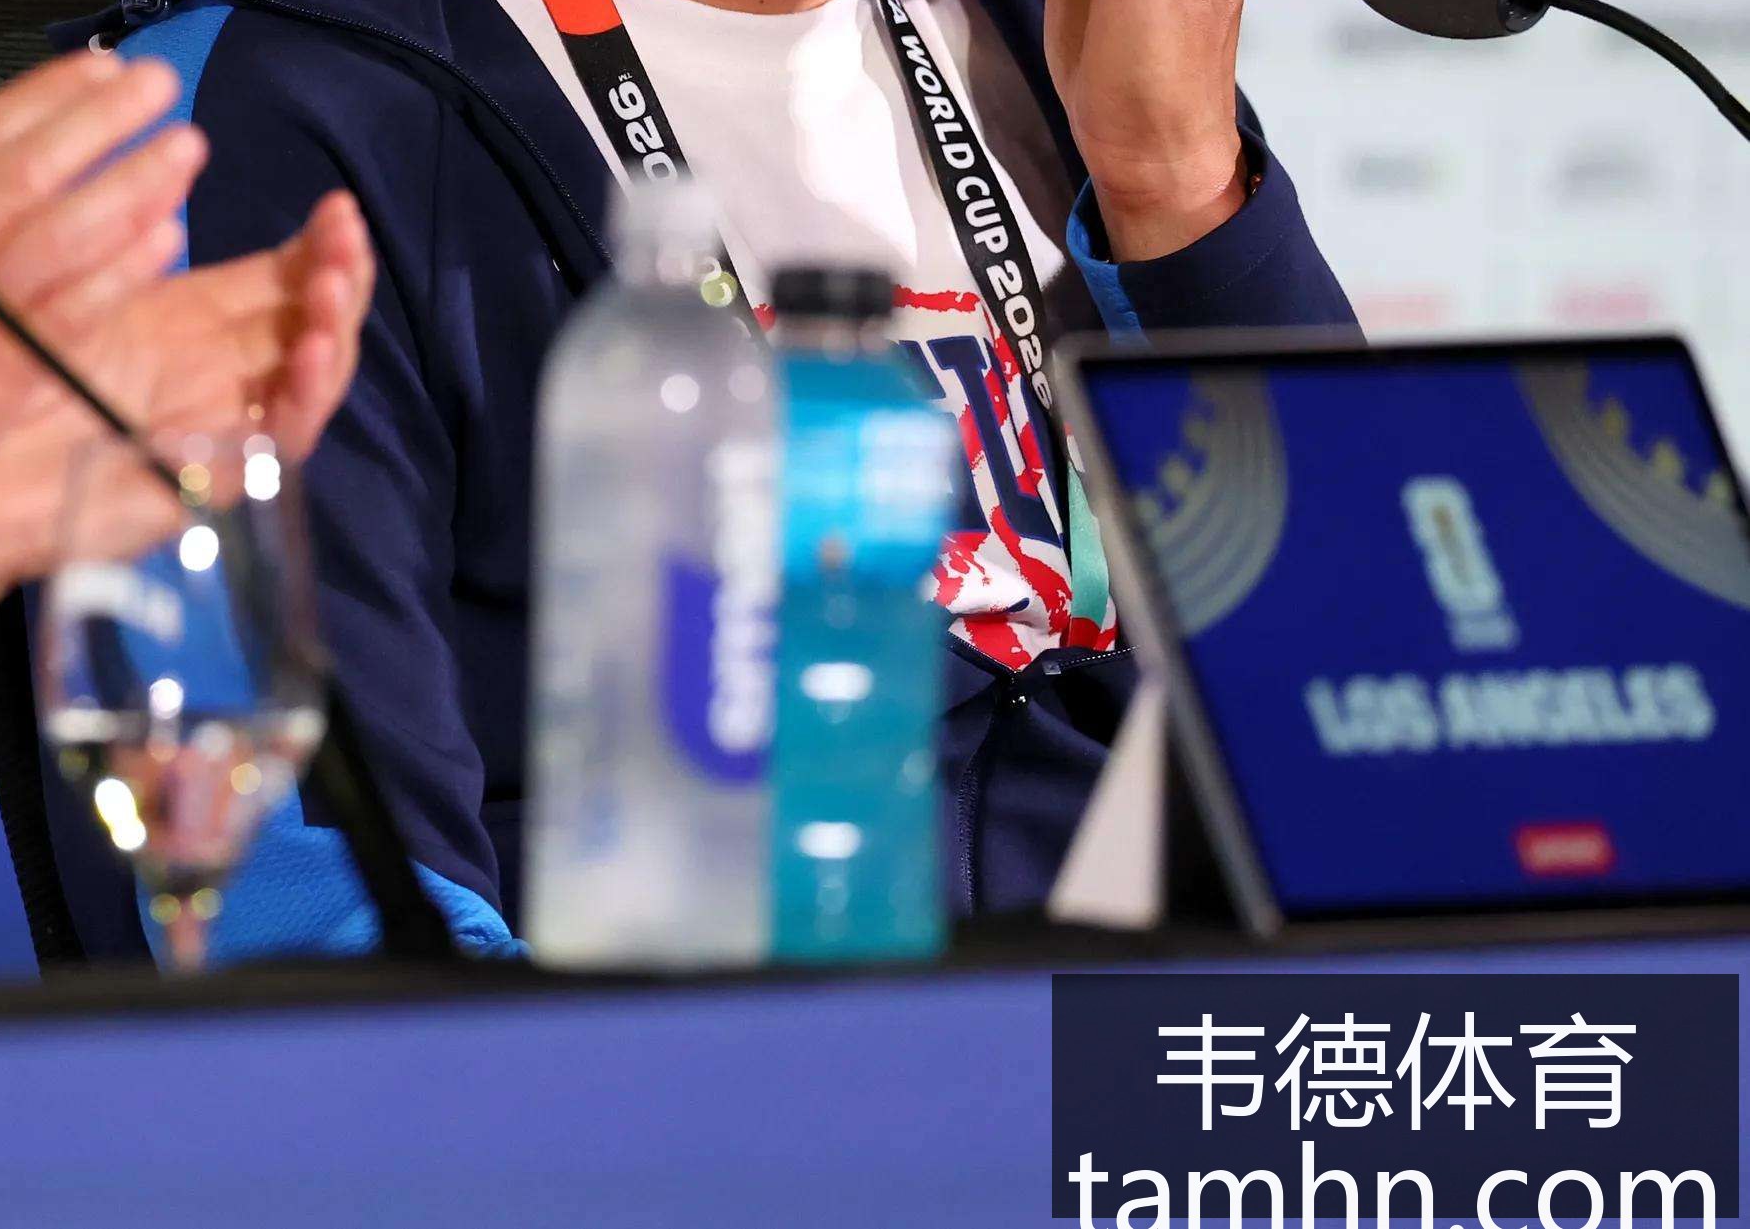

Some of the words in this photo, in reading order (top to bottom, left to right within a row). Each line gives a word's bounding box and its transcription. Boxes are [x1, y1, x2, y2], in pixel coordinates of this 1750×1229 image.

[900, 34, 976, 170] WORLD
[955, 175, 1010, 254] CUP
[986, 259, 1053, 411] 2026
[1303, 674, 1438, 756] LOS
[1439, 662, 1716, 750] ANGELES
